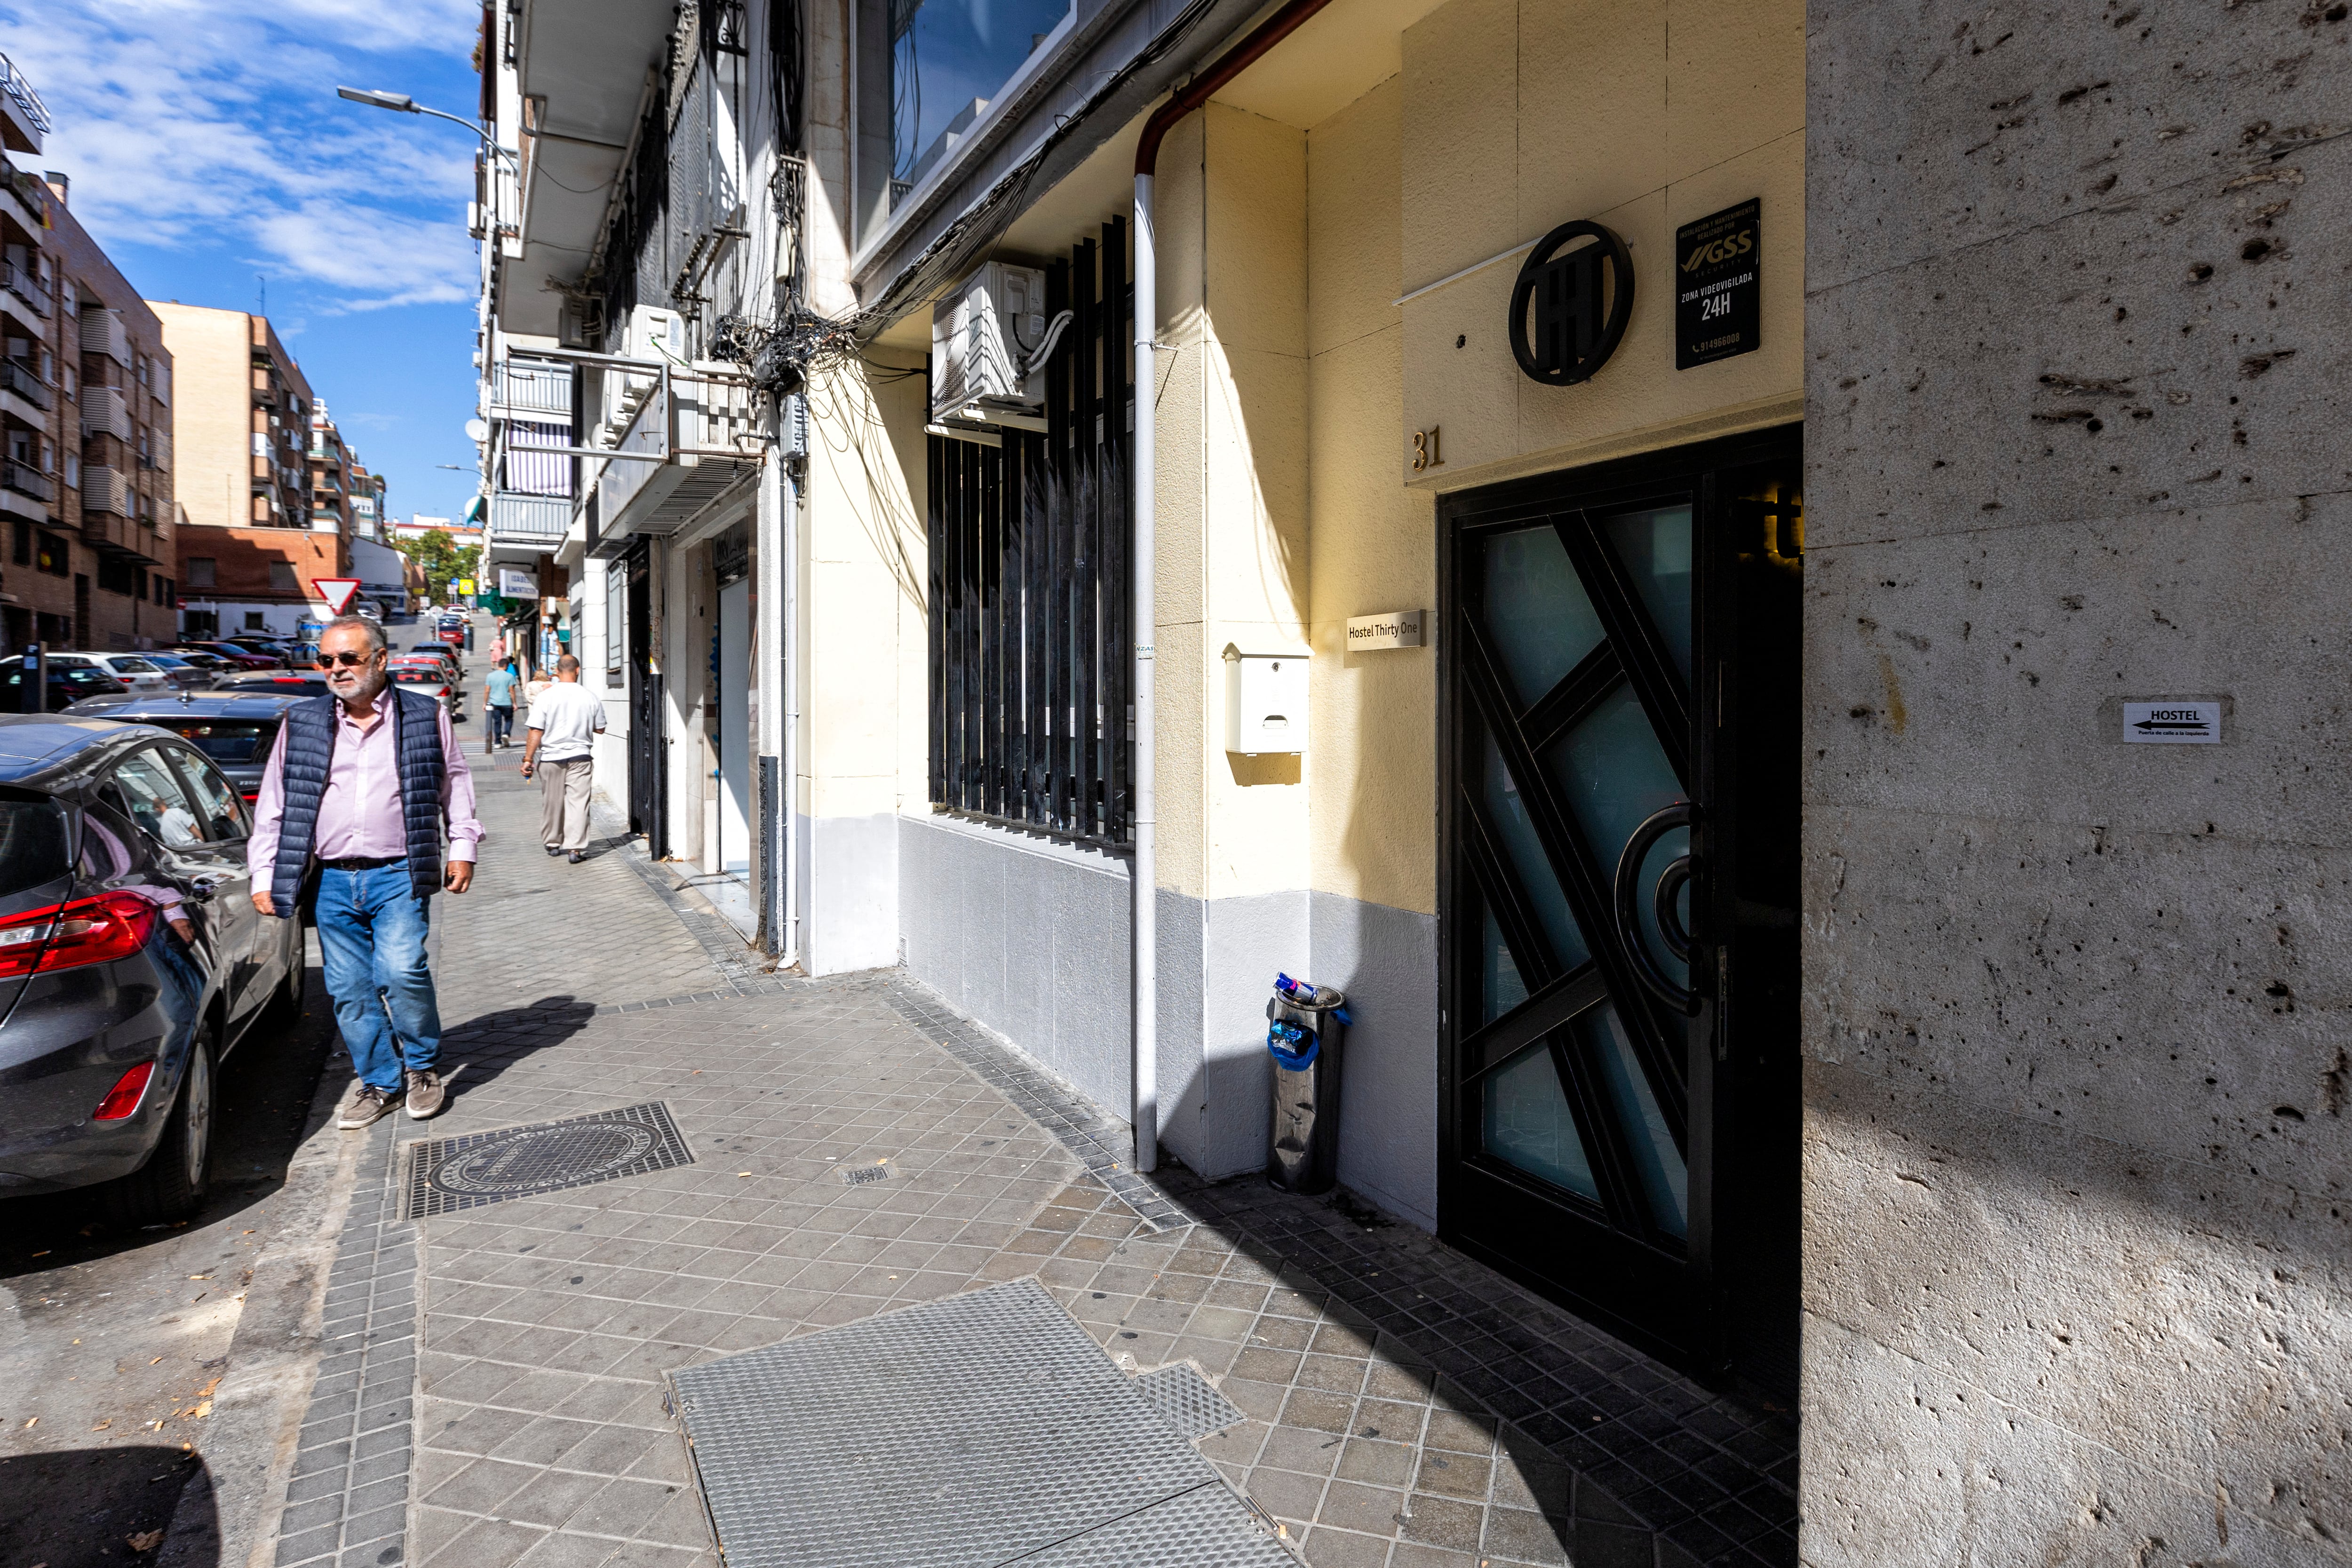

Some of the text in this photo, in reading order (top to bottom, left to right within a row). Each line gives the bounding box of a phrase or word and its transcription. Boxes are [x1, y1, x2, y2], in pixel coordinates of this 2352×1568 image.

[1680, 223, 1708, 239] INSTALACIÓN
[1715, 205, 1755, 225] MANTENIMIENTO
[1698, 221, 1734, 240] REALIZADO POR
[1696, 259, 1740, 278] SECURITY
[1682, 272, 1752, 303] ZONA VIDEOVIGILADA
[1702, 292, 1730, 321] 24H
[1700, 333, 1740, 351] 914966008
[1412, 424, 1445, 471] 31
[1349, 621, 1417, 638] Hostel Thirty One
[2151, 710, 2200, 720] HOSTEL
[491, 1124, 627, 1148] AYUNTAMIENTO
[486, 1146, 524, 1175] REGISTRO
